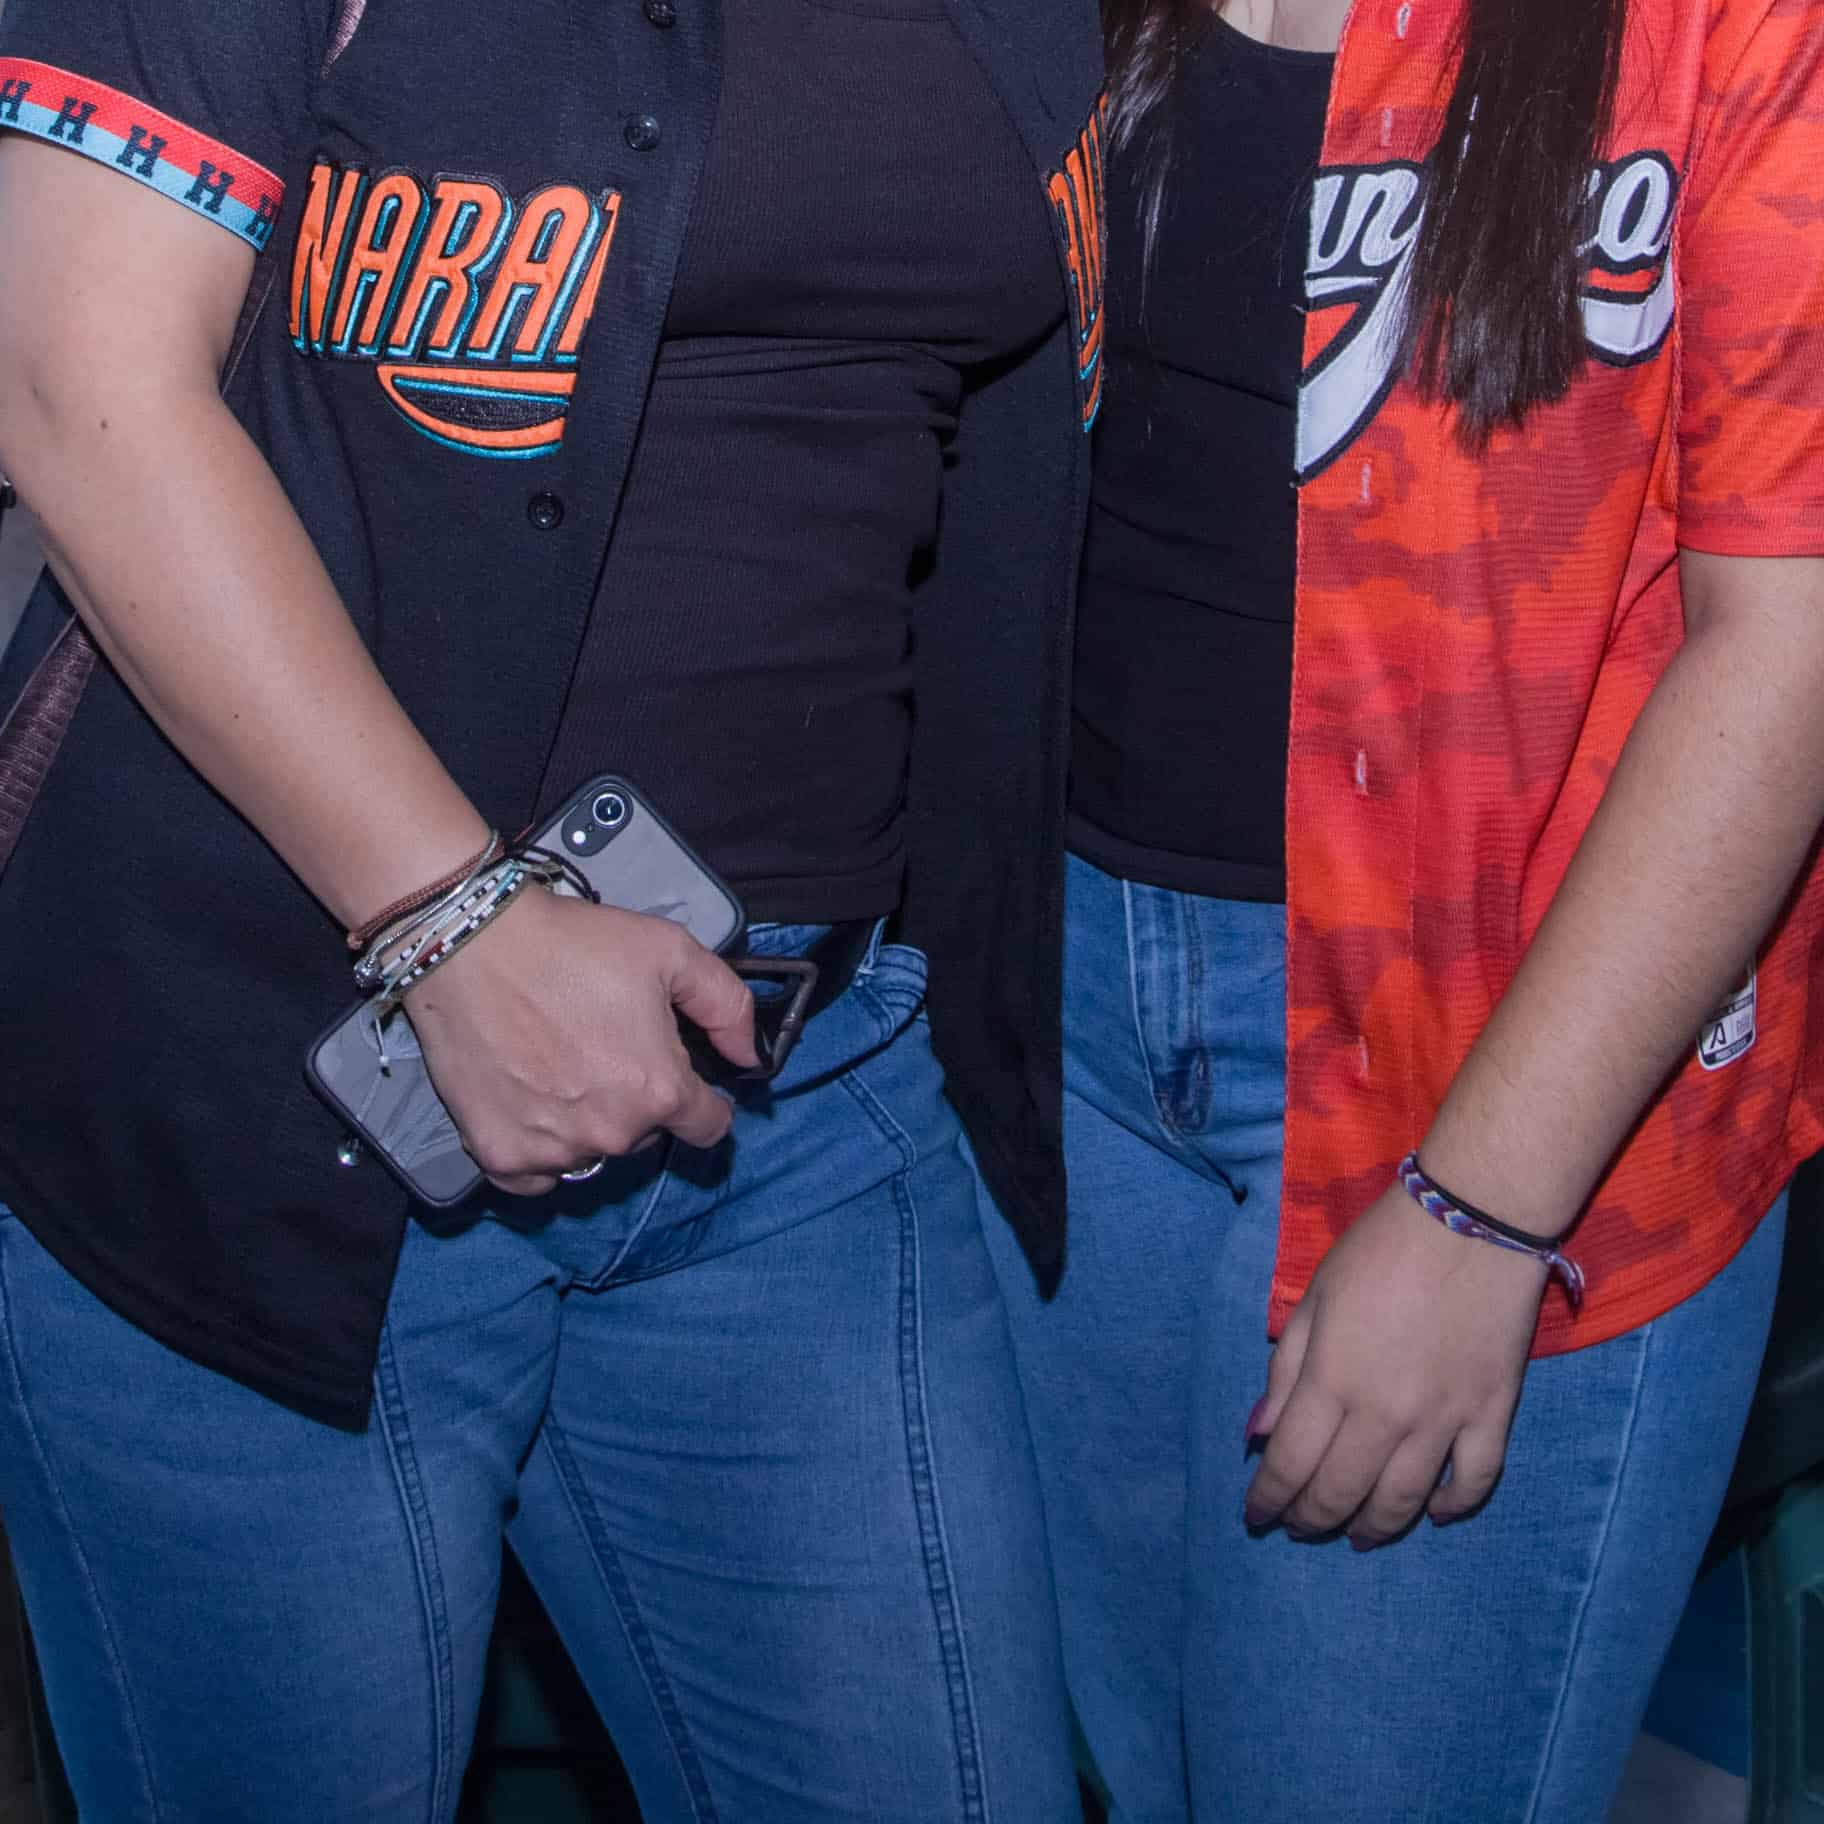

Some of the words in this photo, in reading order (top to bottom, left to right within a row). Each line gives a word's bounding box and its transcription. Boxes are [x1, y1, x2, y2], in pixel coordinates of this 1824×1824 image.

[48, 96, 97, 145] H
[116, 123, 169, 178] H
[183, 159, 235, 215] H
